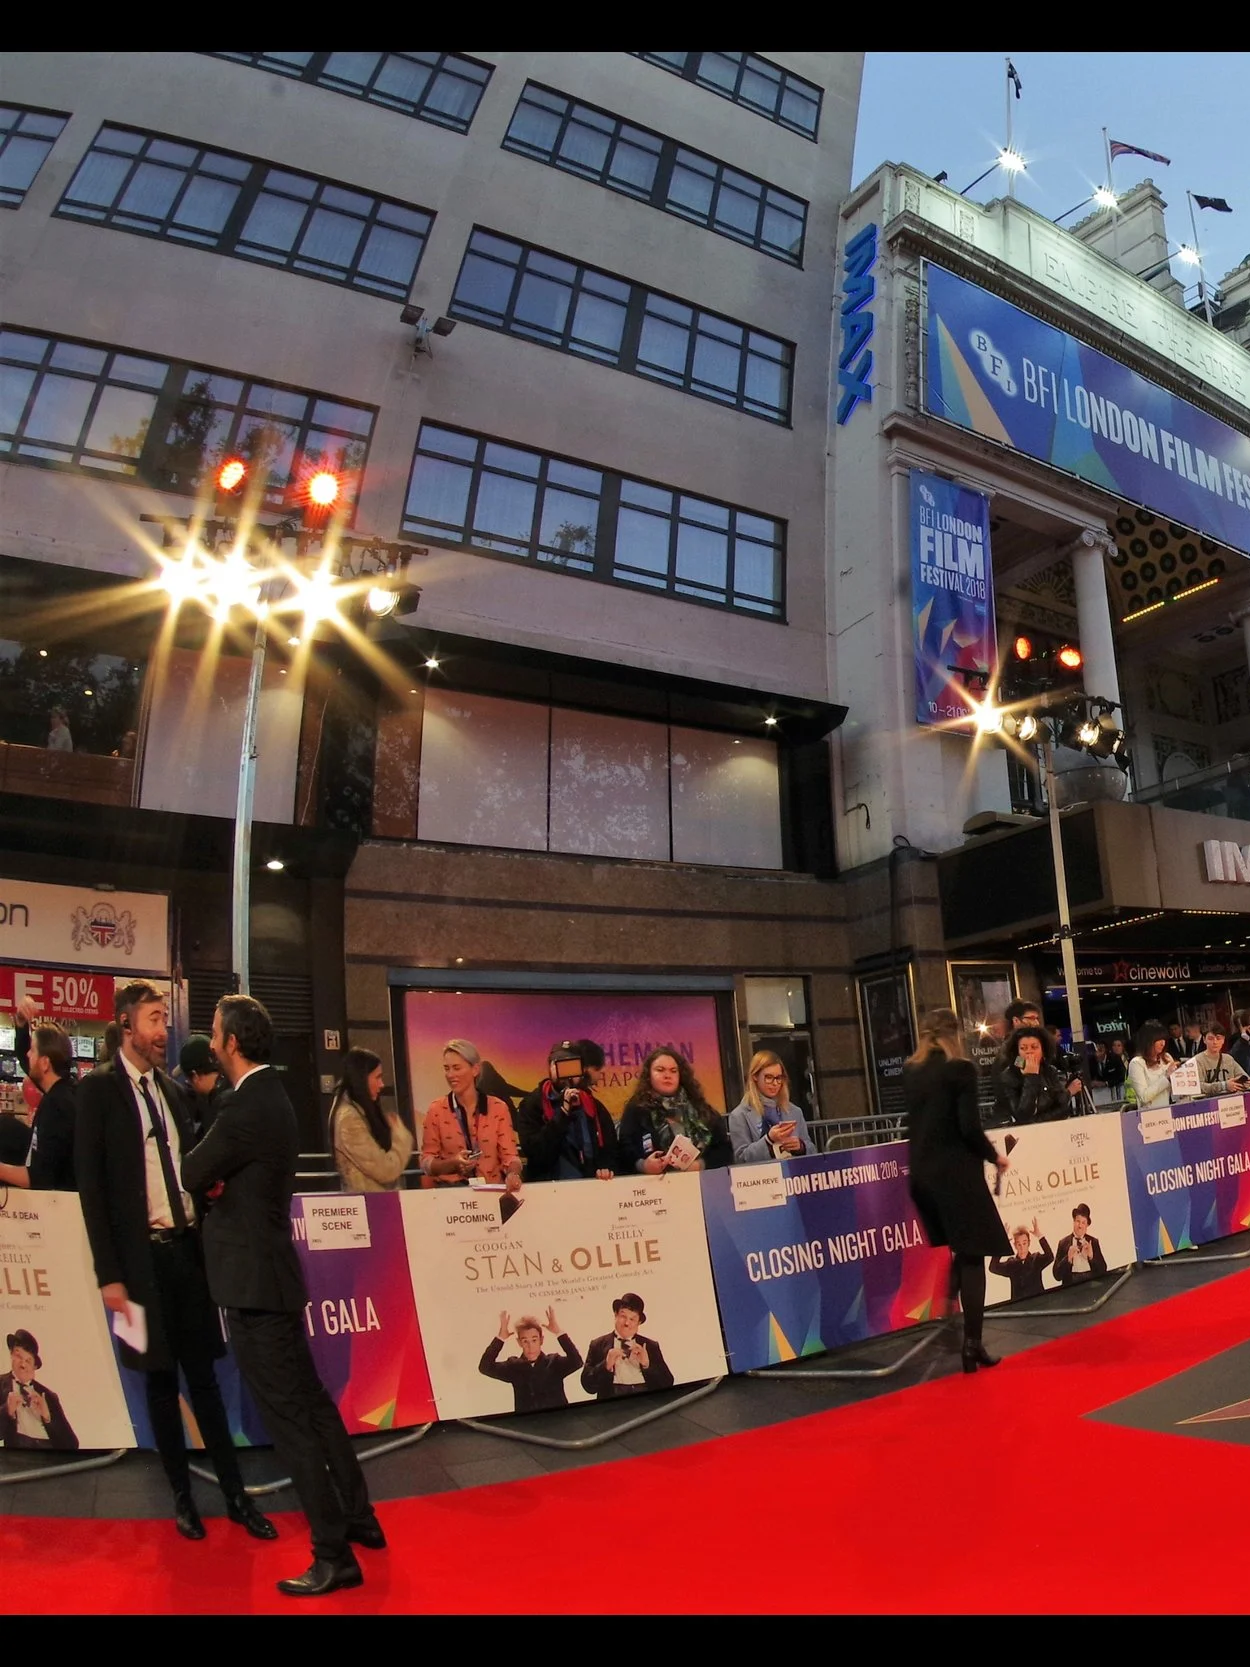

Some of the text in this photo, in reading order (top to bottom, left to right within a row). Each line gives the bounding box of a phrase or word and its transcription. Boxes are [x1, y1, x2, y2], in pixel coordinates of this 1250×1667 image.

[837, 222, 878, 426] IMAX
[1022, 357, 1059, 415] BFI
[1063, 378, 1160, 464] LONDON
[1160, 428, 1223, 497] FILM
[919, 505, 983, 544] BFI LONDON
[920, 525, 985, 580] FILM
[920, 563, 986, 600] FESTIVAL 2018
[1129, 963, 1191, 981] cineworld
[52, 977, 98, 1008] 50%
[1172, 1110, 1220, 1132] DON FILM FESTI
[736, 1177, 779, 1189] ITALIAN REVE
[784, 1174, 811, 1196] DON
[811, 1169, 842, 1192] FILM
[842, 1163, 881, 1187] FESTIVAL
[880, 1160, 898, 1179] 2018
[1035, 1180, 1043, 1192] &
[1047, 1163, 1100, 1188] OLLIE
[1146, 1164, 1194, 1196] CLOSING
[1195, 1156, 1226, 1184] NIGHT
[460, 1201, 478, 1210] THE
[618, 1198, 662, 1209] FAN CARPET
[633, 1189, 647, 1197] THE
[19, 1211, 39, 1220] DEAN
[312, 1208, 358, 1216] PREMIERE
[322, 1222, 352, 1231] SCENE
[446, 1213, 495, 1224] UPCOMING
[474, 1240, 523, 1252] COOGAN
[608, 1229, 645, 1241] REILLY
[464, 1239, 661, 1281] STAN & OLLIE
[746, 1219, 924, 1283] CLOSING NIGHT GALA
[0, 1267, 51, 1297] LIE
[321, 1297, 381, 1336] GALA
